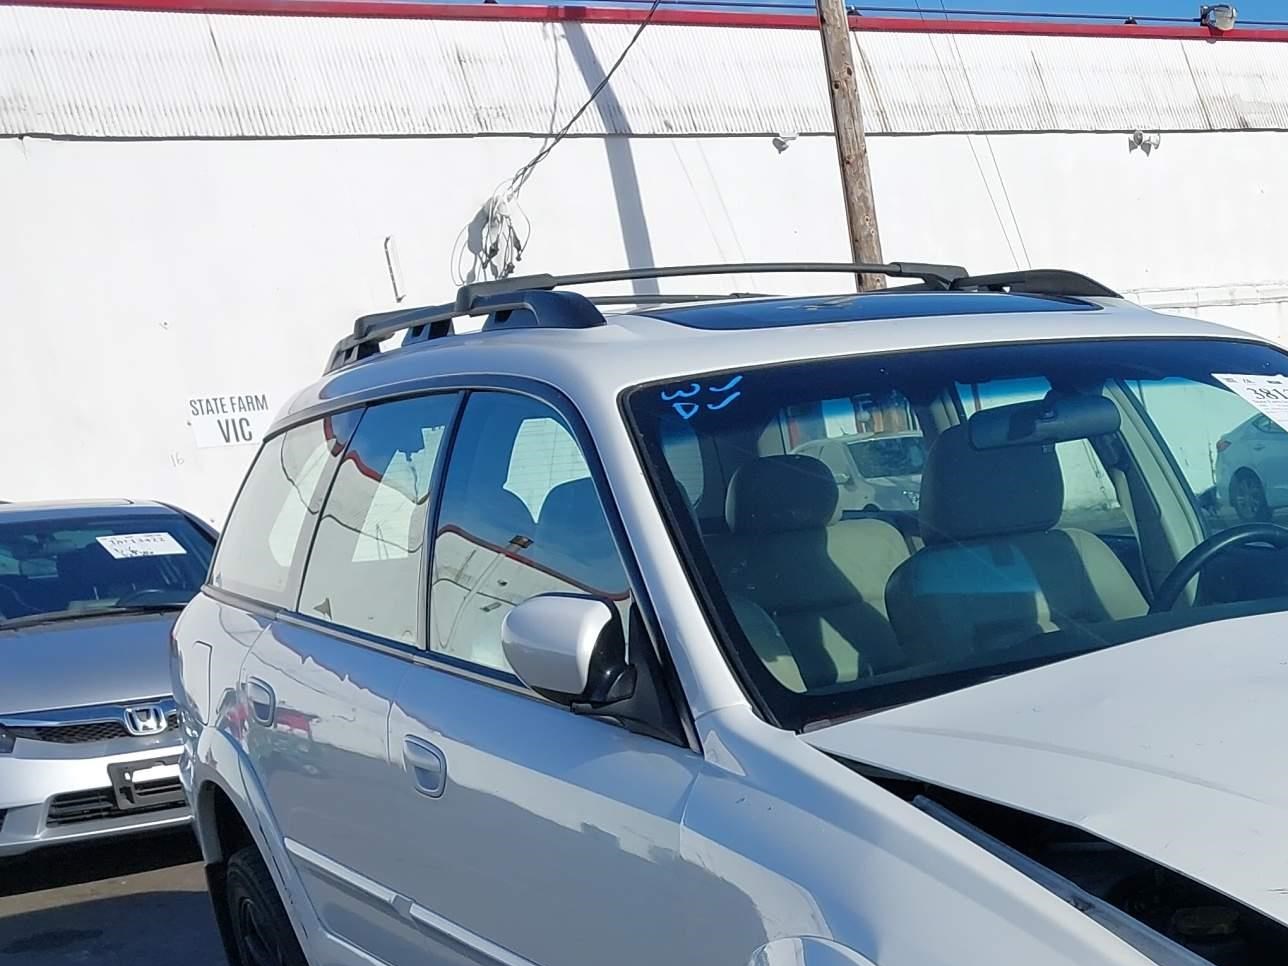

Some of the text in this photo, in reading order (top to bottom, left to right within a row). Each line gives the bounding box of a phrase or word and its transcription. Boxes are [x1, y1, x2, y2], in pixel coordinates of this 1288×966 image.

[189, 394, 269, 416] STATE FARM
[217, 417, 253, 443] VIC
